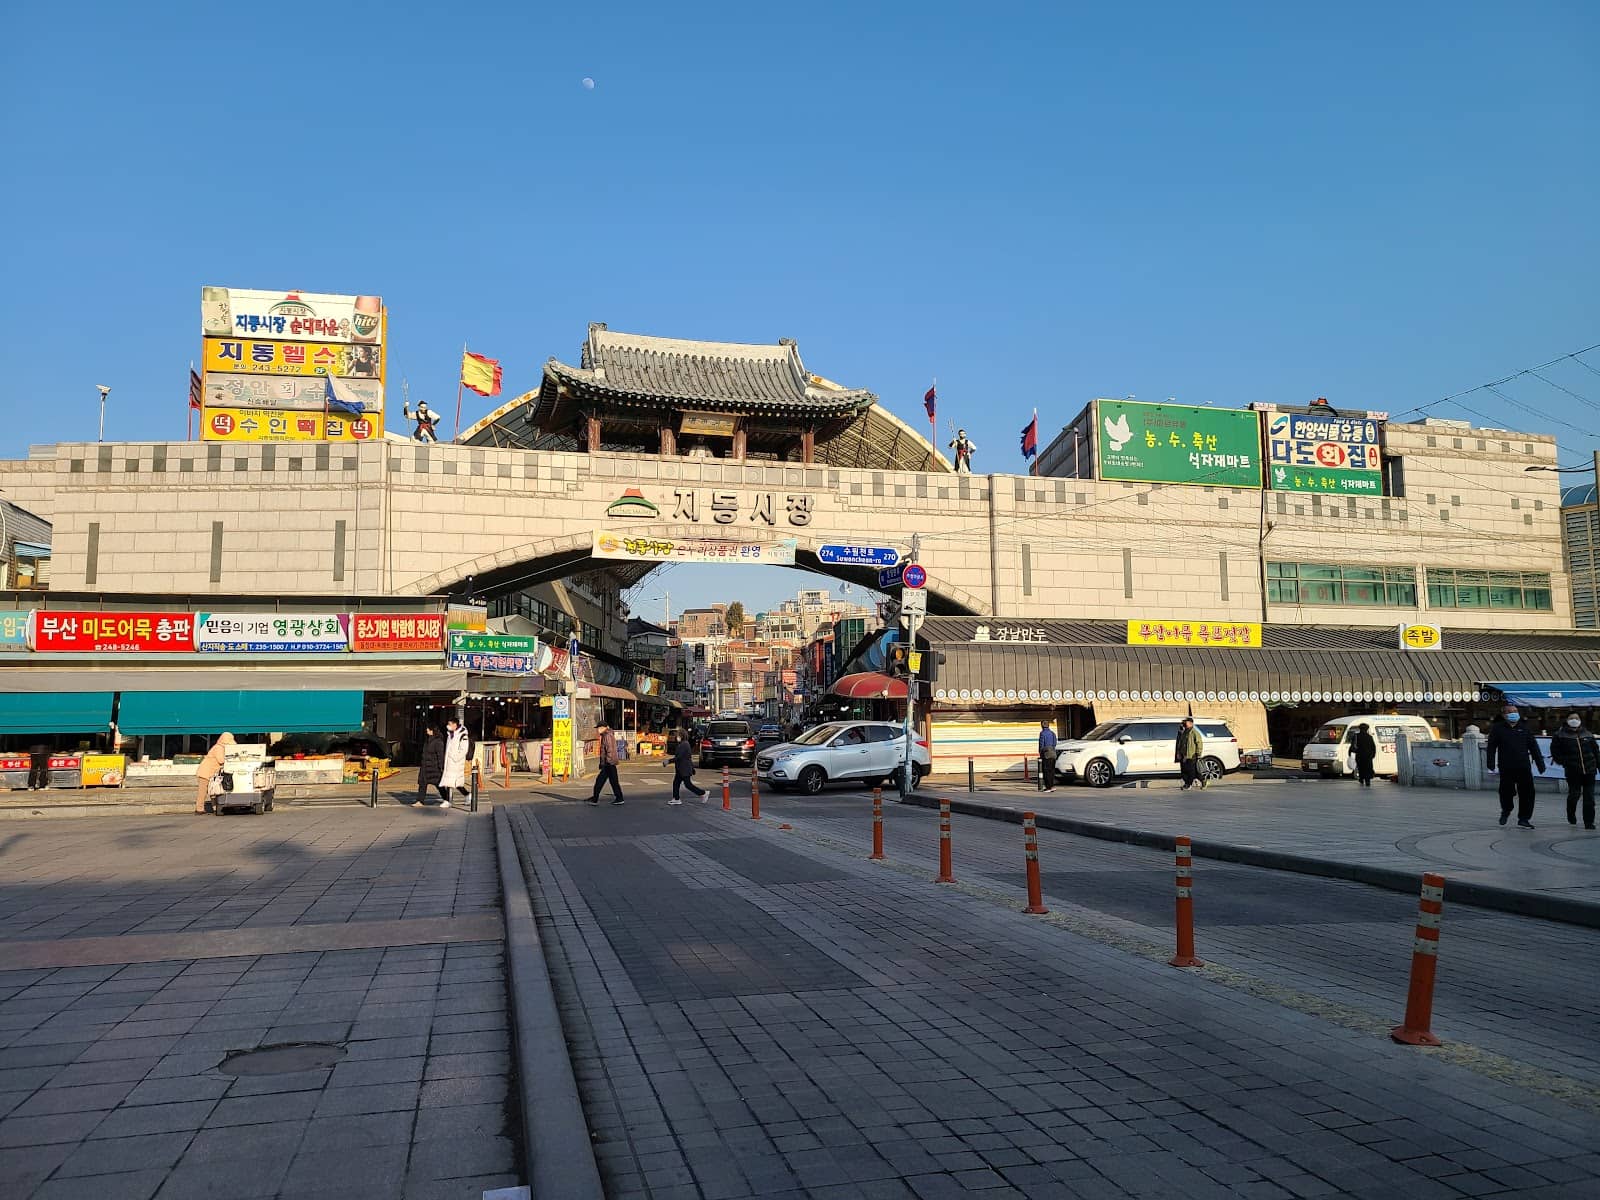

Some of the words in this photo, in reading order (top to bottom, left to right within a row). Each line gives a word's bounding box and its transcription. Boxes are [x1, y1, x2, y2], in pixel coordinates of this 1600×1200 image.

[236, 314, 286, 333] 지동시장
[290, 317, 340, 336] 순대타운
[354, 314, 379, 327] hite
[214, 416, 231, 431] 떡
[352, 423, 370, 438] 떡
[1189, 452, 1251, 470] 식자재마트
[1340, 479, 1377, 489] 식자재마트
[672, 487, 815, 526] 지동시장
[740, 545, 762, 558] 환영
[821, 549, 834, 557] 274
[883, 553, 896, 561] 270
[41, 617, 78, 641] 부산
[82, 618, 153, 641] 미도어묵
[156, 618, 191, 641] 총판
[206, 620, 244, 634] 믿음의
[247, 622, 269, 634] 기업
[273, 619, 339, 637] 영광상회
[357, 619, 389, 639] 중소기업
[391, 620, 415, 637] 박람회
[416, 620, 441, 638] 전시장
[1407, 629, 1435, 643] 족발
